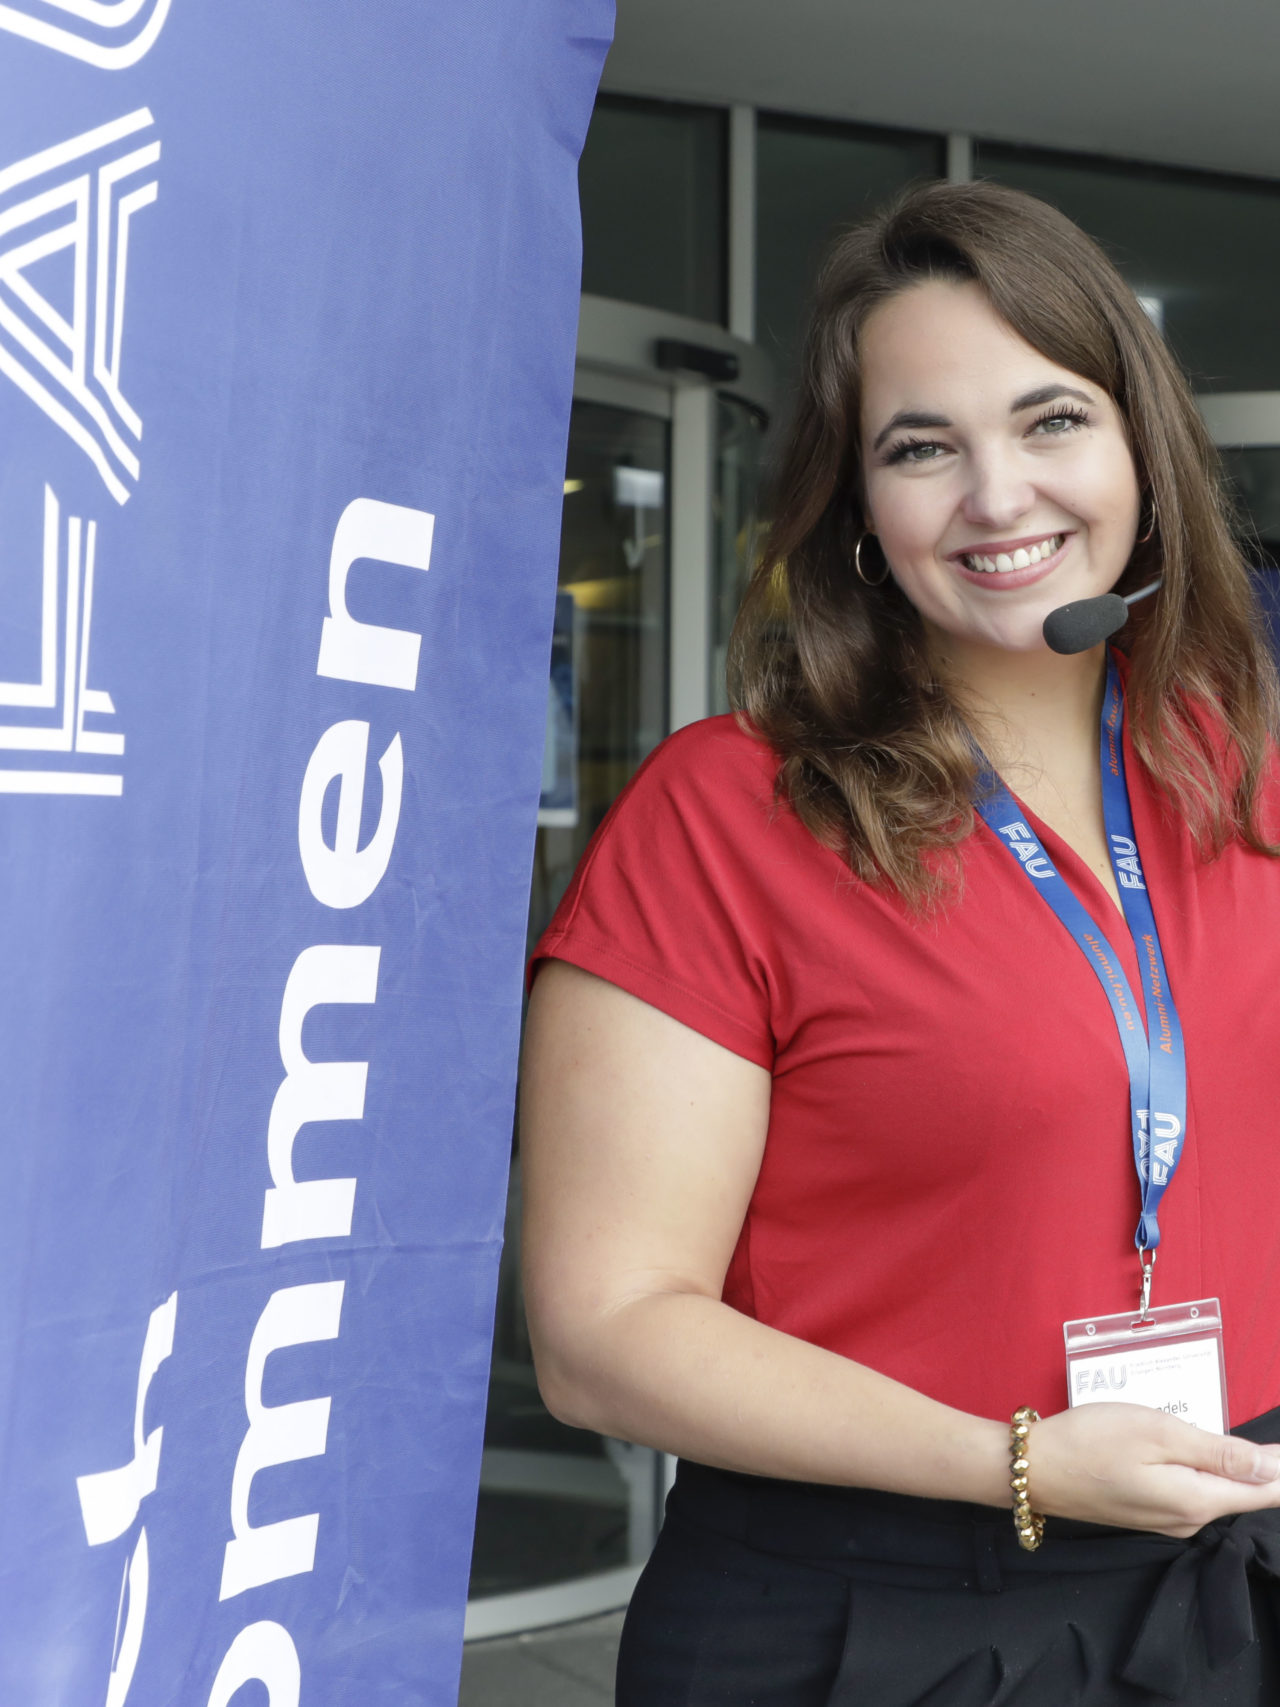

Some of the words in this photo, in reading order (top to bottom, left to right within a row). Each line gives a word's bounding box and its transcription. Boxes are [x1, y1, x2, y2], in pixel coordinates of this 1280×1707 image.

[999, 821, 1056, 879] FAU
[1110, 834, 1147, 890] FAU
[1083, 933, 1136, 1031] alumni.fau.eu
[1142, 933, 1173, 1055] Alumni-Netzwerk
[1153, 1112, 1181, 1186] FAU
[1076, 1365, 1128, 1395] FAU
